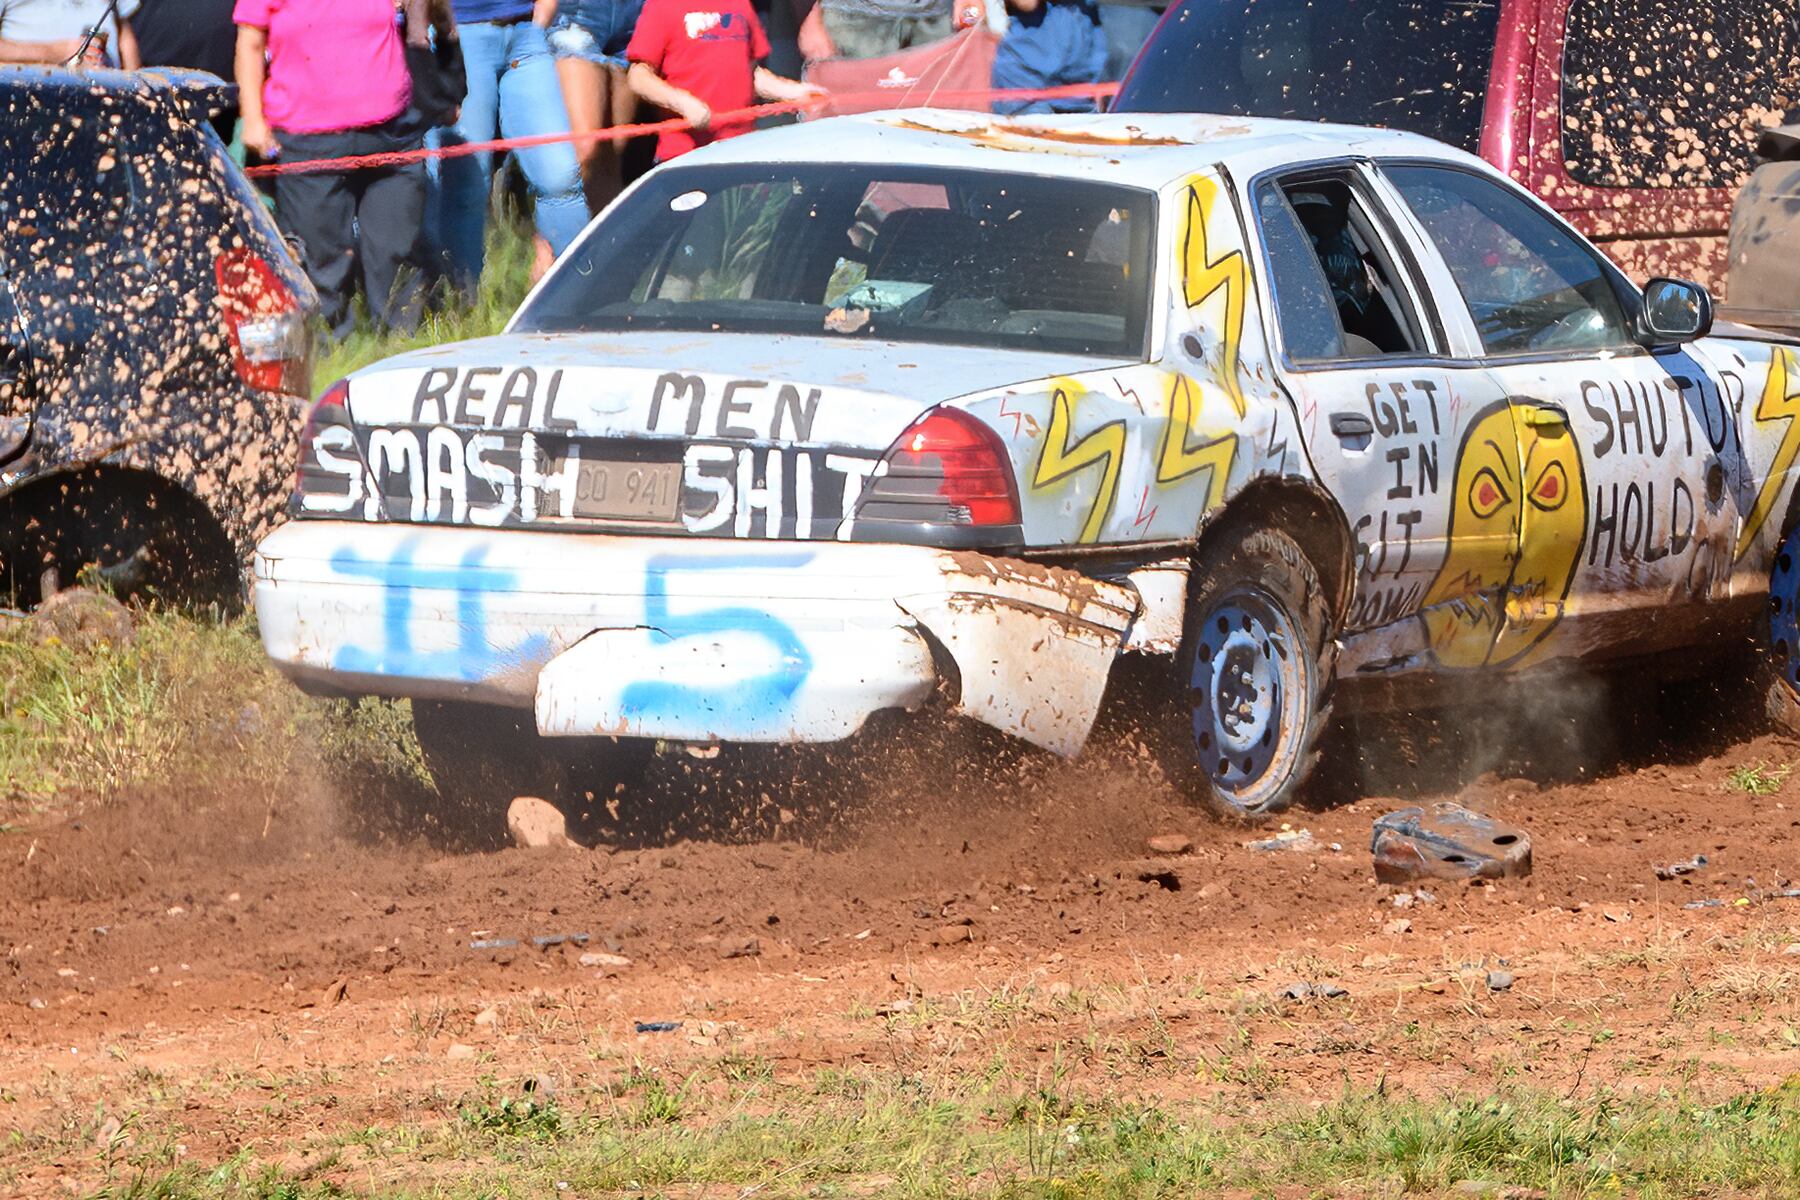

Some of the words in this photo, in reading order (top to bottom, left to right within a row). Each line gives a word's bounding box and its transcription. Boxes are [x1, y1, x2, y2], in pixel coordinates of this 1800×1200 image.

[412, 367, 578, 428] REAL
[647, 373, 822, 442] MEN
[1365, 379, 1440, 439] GET
[302, 425, 580, 526] SMASH
[682, 445, 889, 542] SHIT
[627, 469, 672, 506] 941
[1386, 440, 1439, 500] IN
[1353, 509, 1422, 582] SIT
[1588, 477, 1695, 568] HOLD
